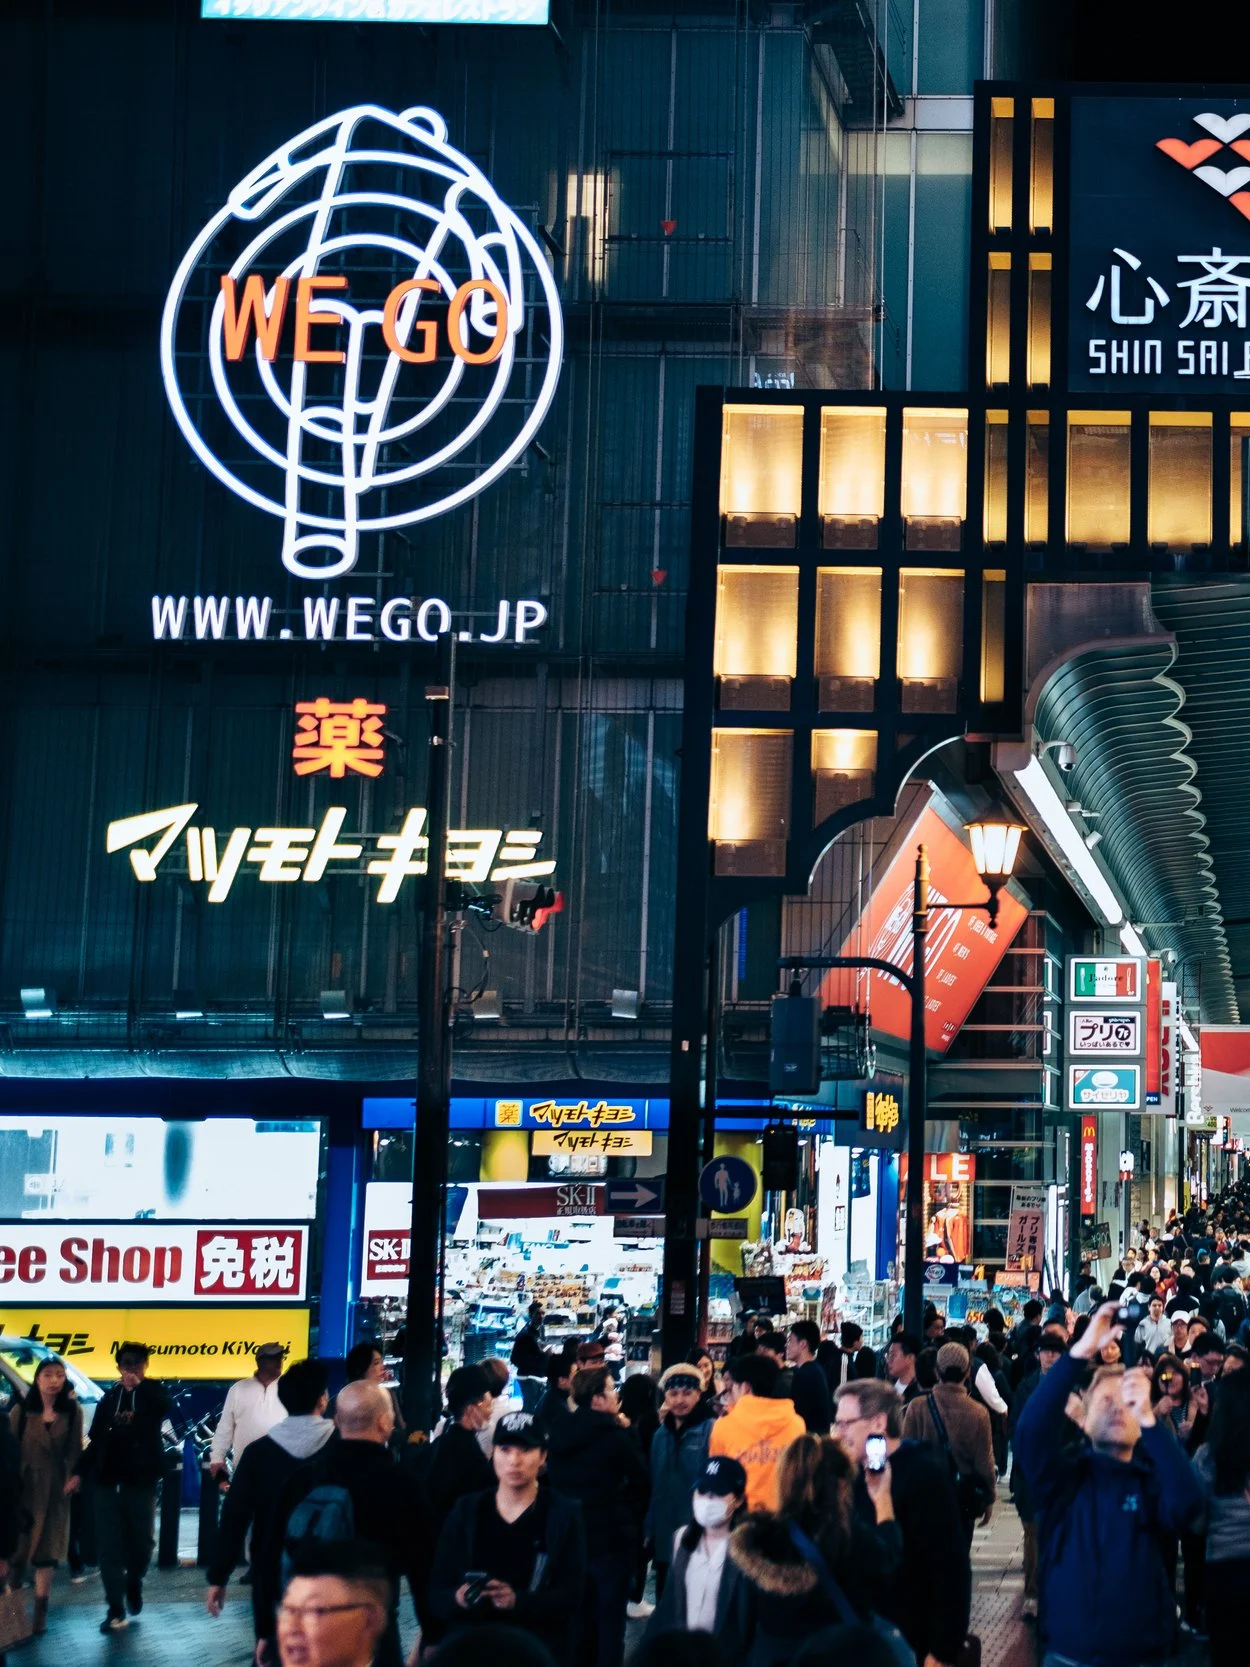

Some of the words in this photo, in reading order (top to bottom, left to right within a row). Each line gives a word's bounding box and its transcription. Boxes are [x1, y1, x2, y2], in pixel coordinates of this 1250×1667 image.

[1089, 339, 1162, 375] SHIN
[1178, 340, 1228, 376] SAI
[151, 595, 549, 643] WWW.WEGO.JP
[293, 698, 387, 778] 薬
[106, 803, 556, 902] マツモトキヨシ
[1080, 1023, 1113, 1041] プリ
[532, 1102, 635, 1126] マツモトキヨシ
[553, 1130, 633, 1152] マツモトキヨシ
[556, 1187, 596, 1206] SK-II
[60, 1237, 183, 1288] Shop
[200, 1236, 296, 1289] 免税
[110, 1341, 216, 1356] Msumoto
